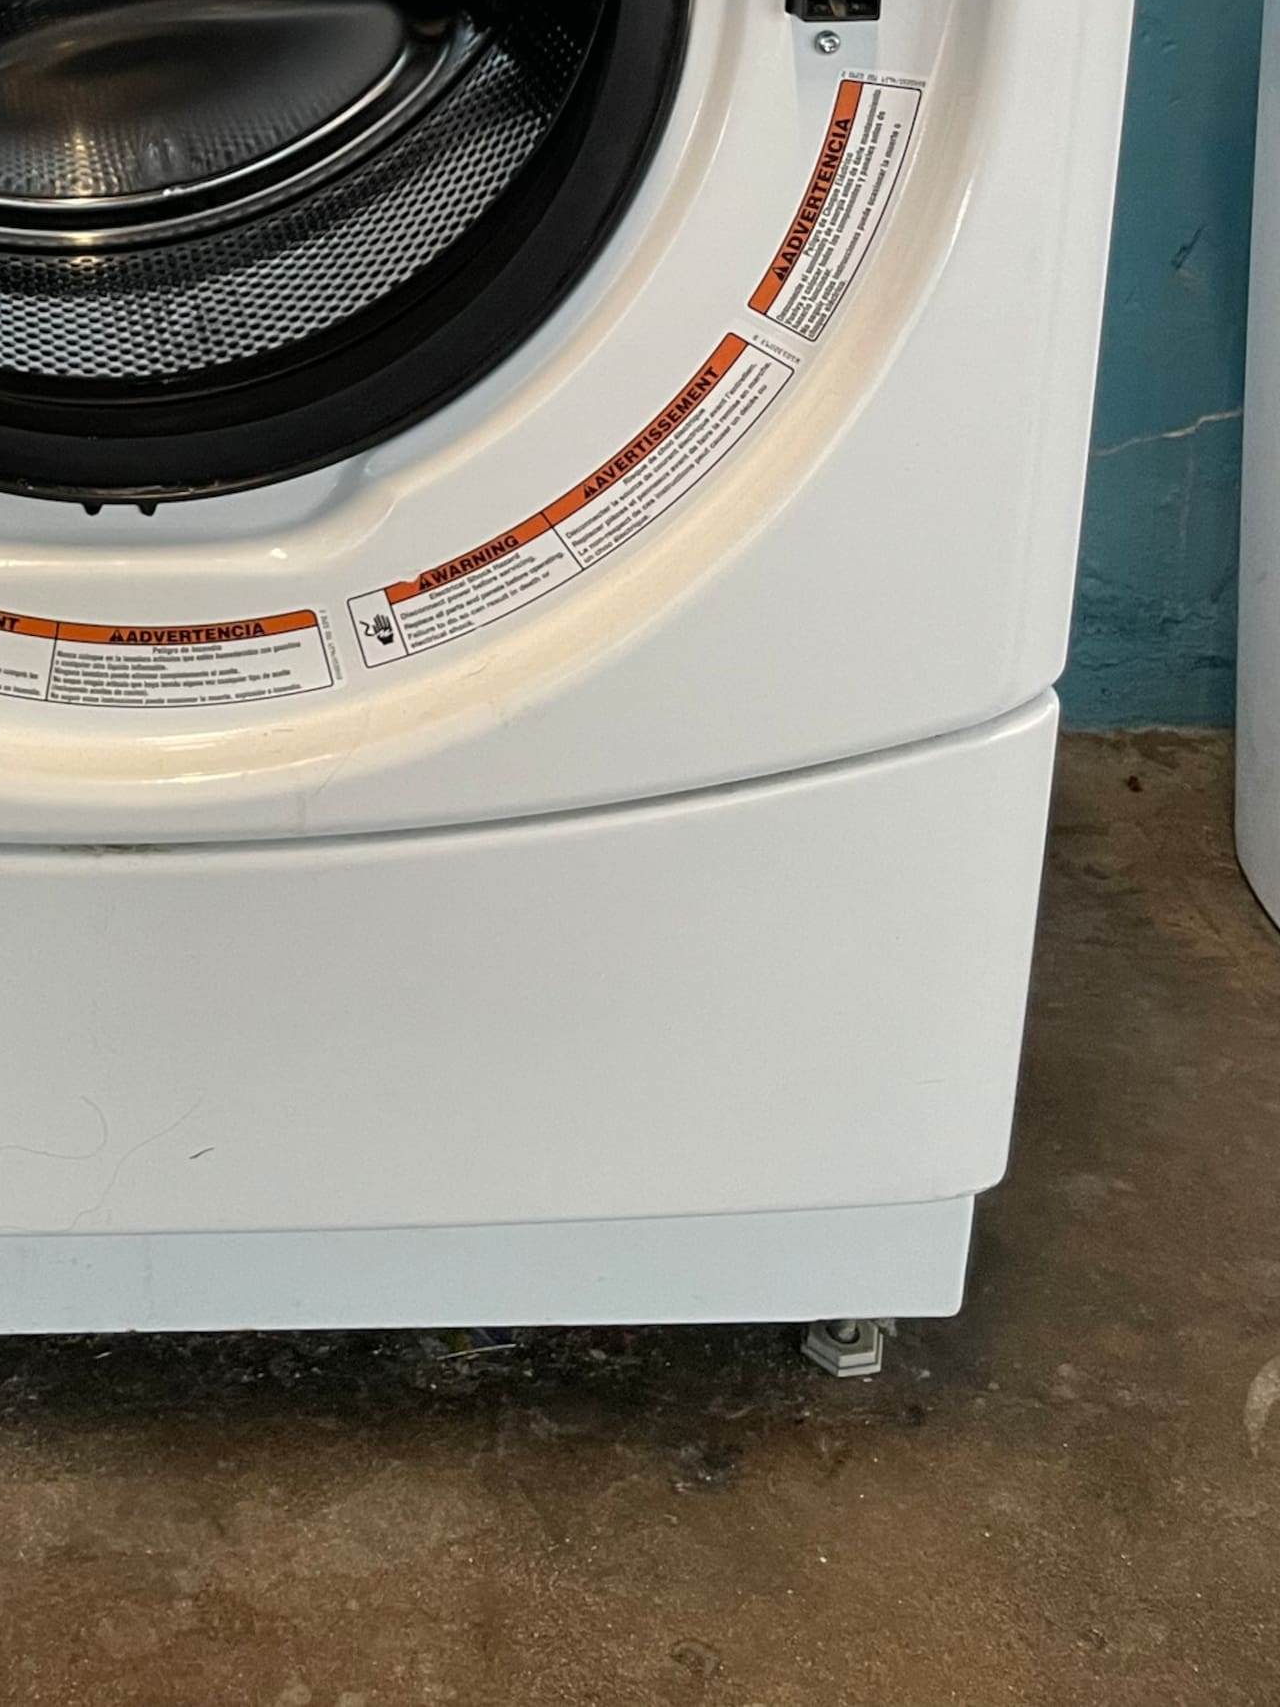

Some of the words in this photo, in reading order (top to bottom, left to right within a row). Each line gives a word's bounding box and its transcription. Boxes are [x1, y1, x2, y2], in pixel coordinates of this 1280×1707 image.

[781, 117, 852, 264] ADVERTENCIA
[595, 366, 718, 490] AVERTISSEMENT
[430, 535, 519, 584] WARNING
[126, 622, 265, 643] ADVERTENCIA
